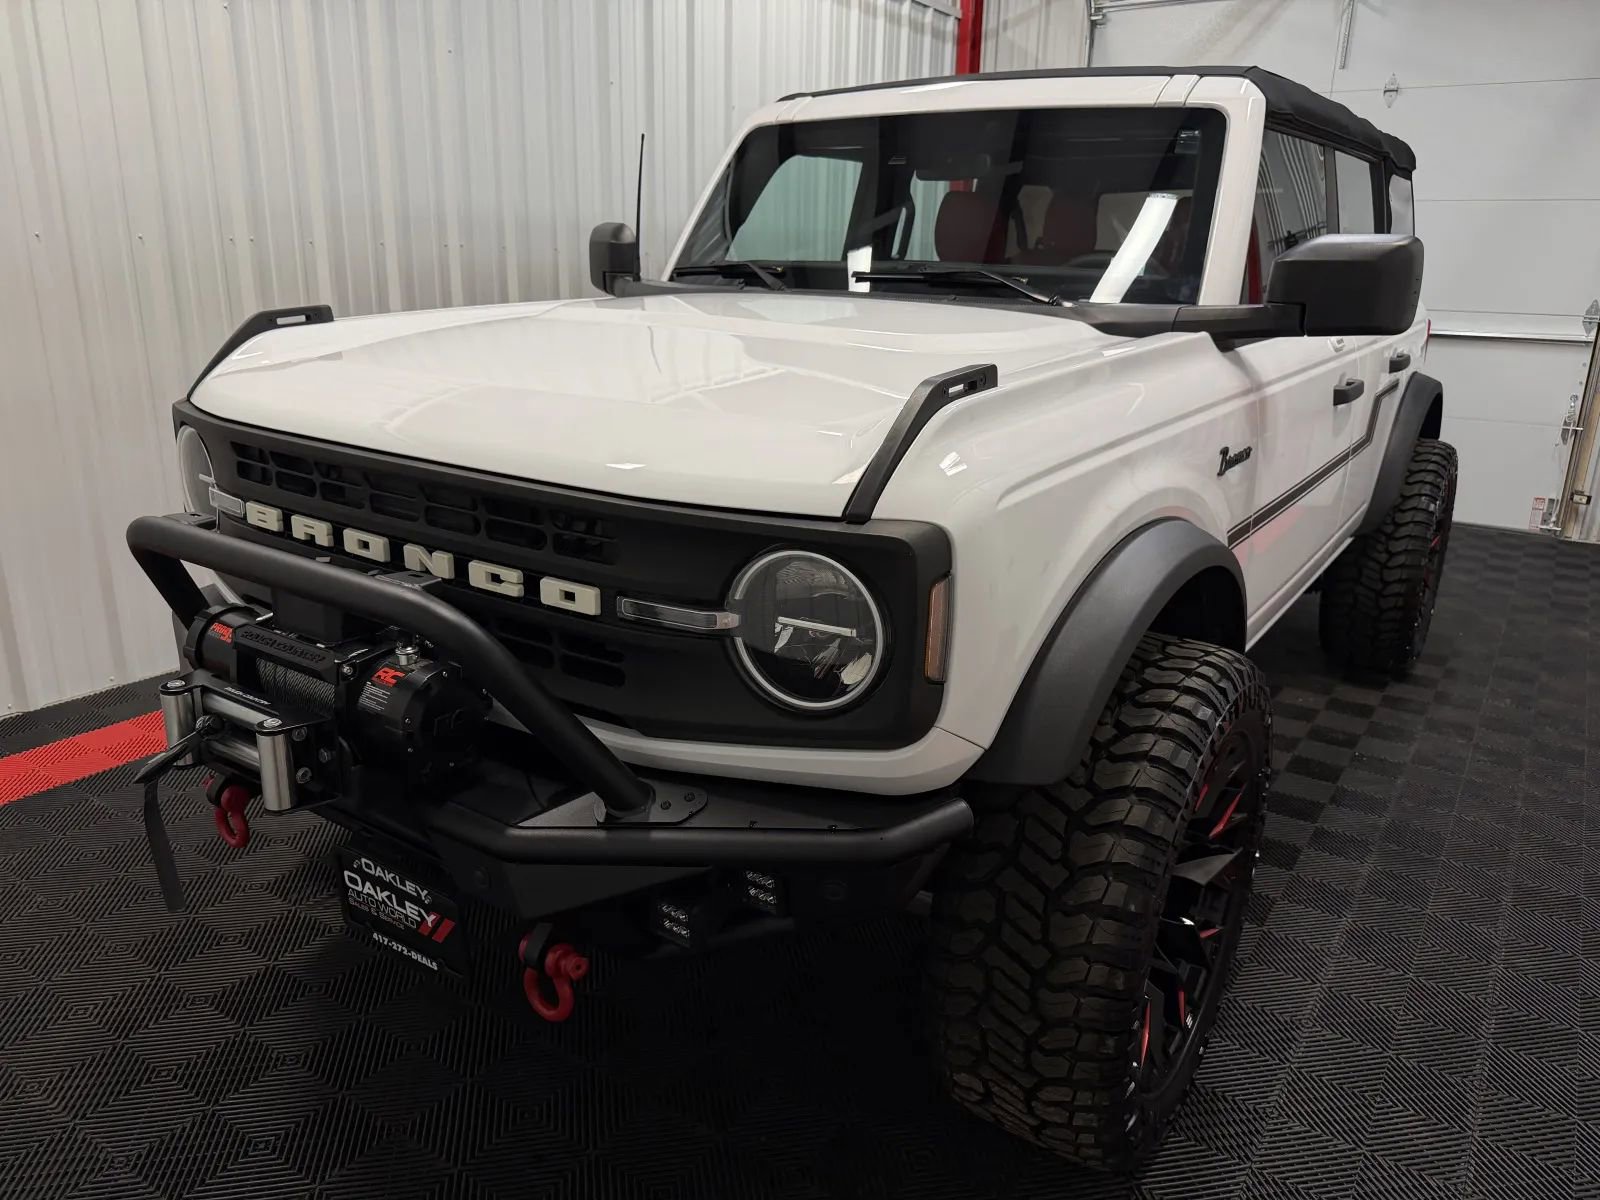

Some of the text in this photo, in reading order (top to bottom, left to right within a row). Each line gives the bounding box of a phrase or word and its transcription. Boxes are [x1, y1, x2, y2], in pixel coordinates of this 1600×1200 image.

[245, 501, 602, 616] BRONCO
[373, 666, 406, 685] RC
[344, 870, 437, 927] OAKLEY
[361, 857, 428, 901] OAKLEY
[347, 888, 417, 929] AUTO WORLD
[372, 932, 439, 971] 417-272-DEALS
